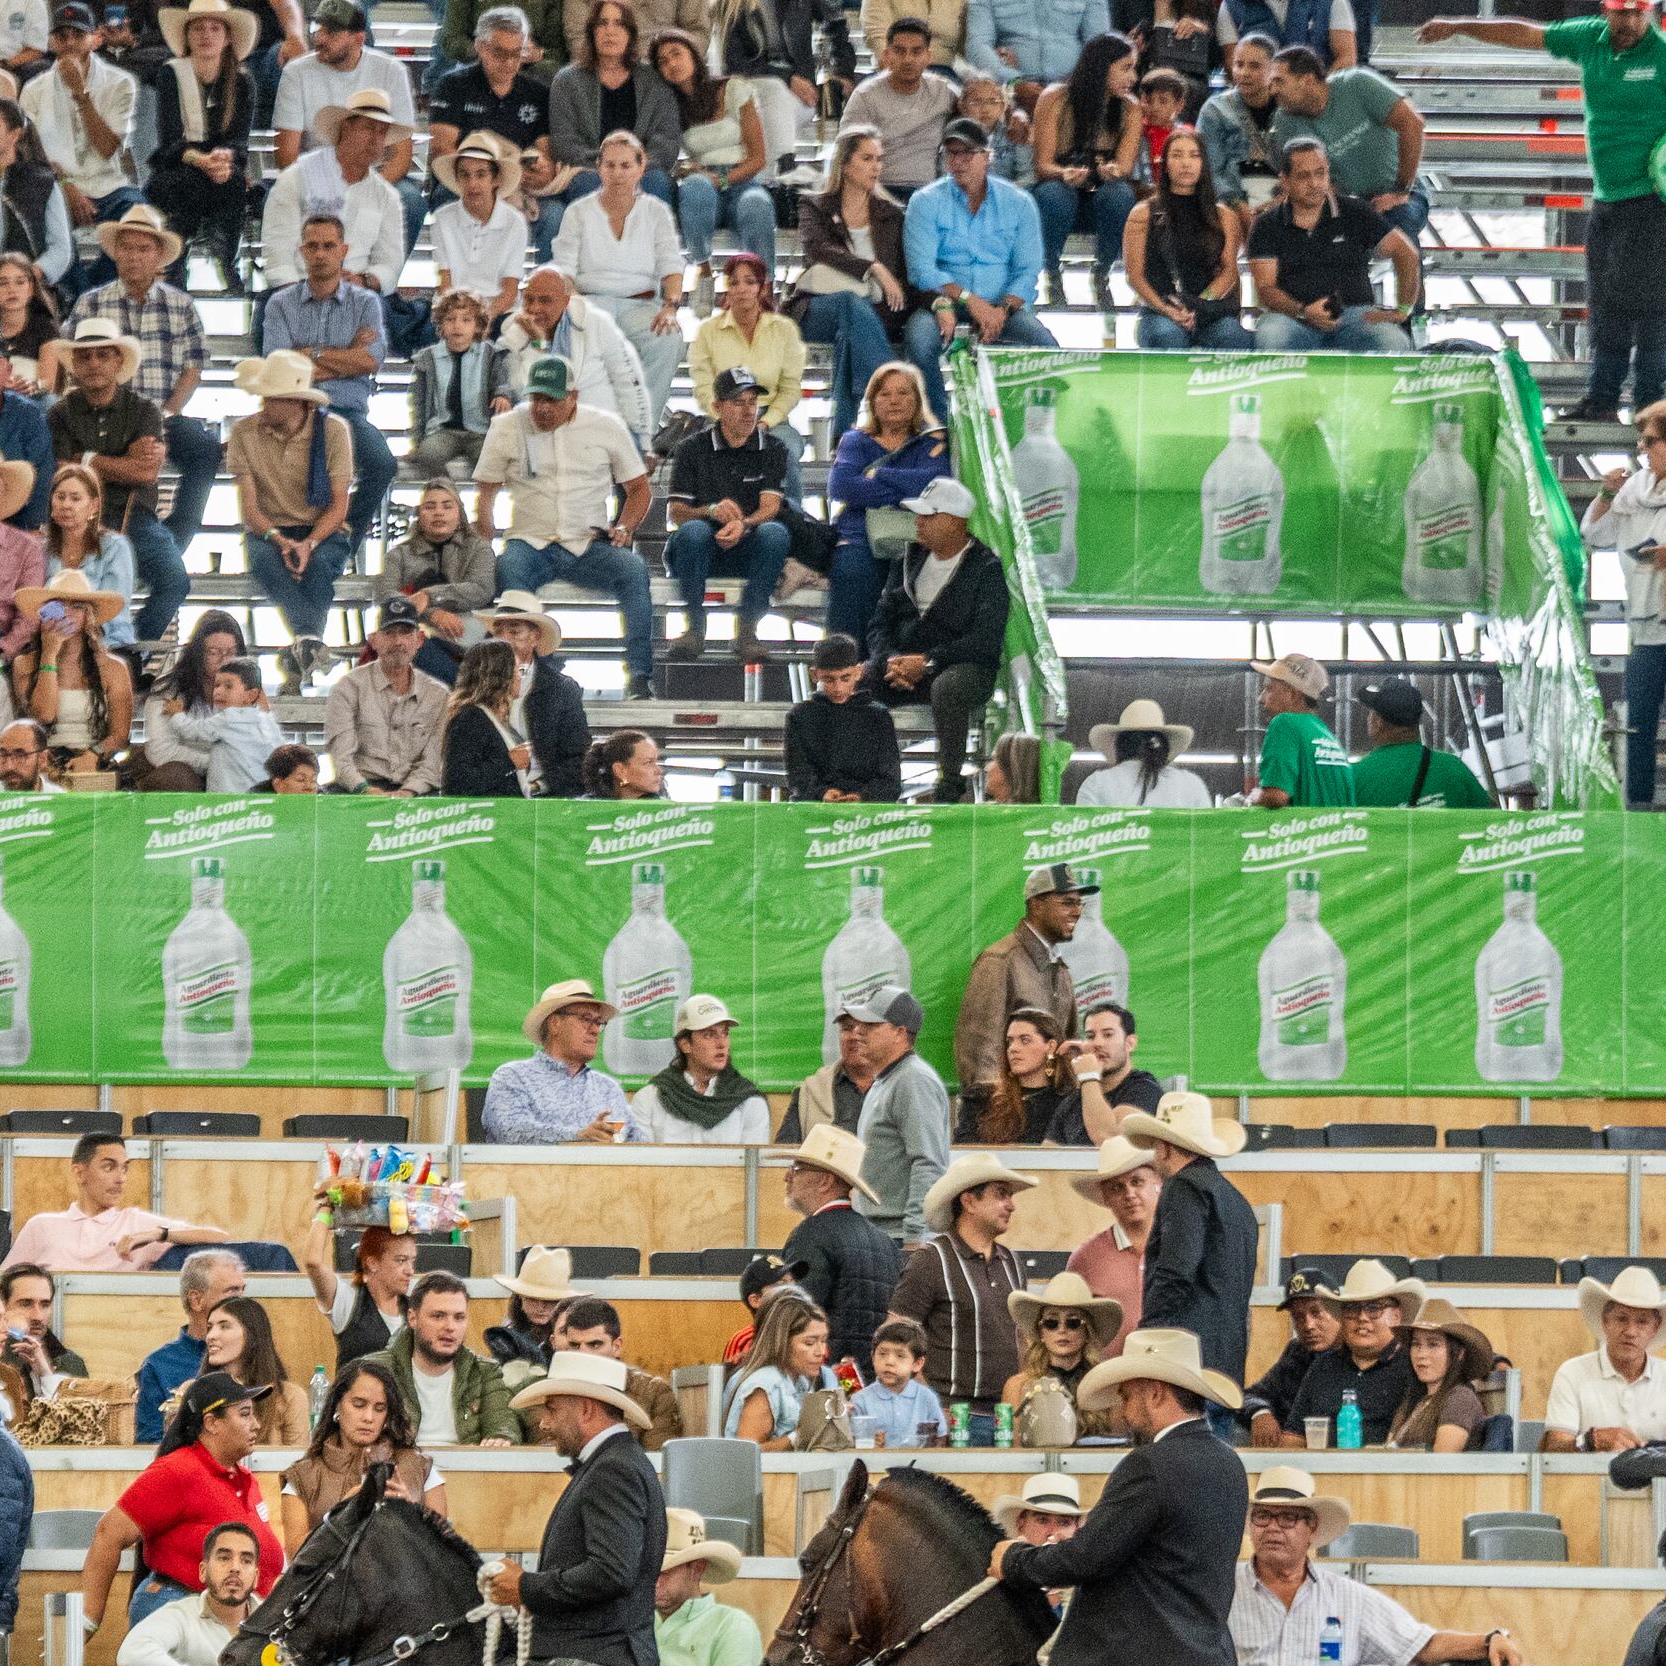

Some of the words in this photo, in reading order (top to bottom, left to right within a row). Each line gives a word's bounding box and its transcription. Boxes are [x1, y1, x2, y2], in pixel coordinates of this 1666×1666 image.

[173, 805, 211, 826] Solo
[213, 800, 247, 817] con
[394, 807, 432, 829] Solo
[434, 803, 467, 820] con
[614, 811, 652, 833] Solo
[654, 806, 687, 823] con
[832, 813, 870, 835] Solo
[873, 808, 907, 826] con
[1050, 816, 1089, 837] Solo
[1091, 811, 1123, 828] con
[1268, 818, 1306, 840] Solo
[1308, 813, 1341, 831] con
[1485, 820, 1524, 841] Solo
[1526, 815, 1559, 833] con
[145, 812, 274, 849] Antioqueño
[366, 815, 494, 852] Antioqueño
[586, 818, 714, 855] Antioqueño
[805, 820, 931, 859] Antioqueño
[1024, 823, 1149, 861] Antioqueño
[1242, 825, 1368, 863] Antioqueño
[1459, 826, 1584, 865] Antioqueño
